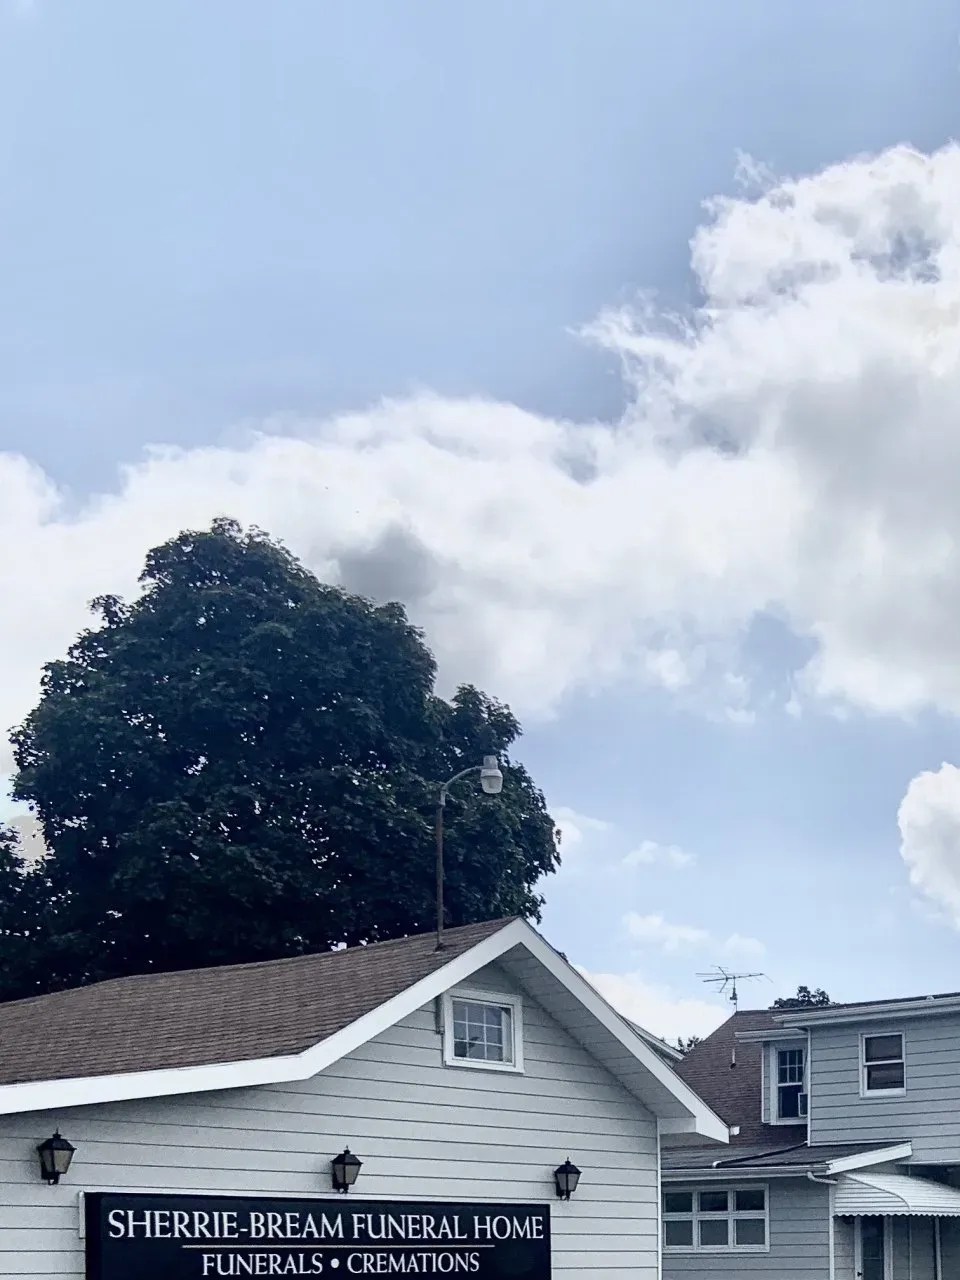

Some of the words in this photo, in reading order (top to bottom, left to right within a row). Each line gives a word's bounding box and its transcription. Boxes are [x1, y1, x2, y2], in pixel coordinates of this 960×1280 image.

[108, 1209, 344, 1239] SHERRIE-BREAM
[352, 1213, 468, 1239] FUNERAL
[474, 1215, 544, 1240] HOME
[202, 1252, 323, 1276] FUNERALS
[347, 1251, 480, 1274] CREMATIONS
